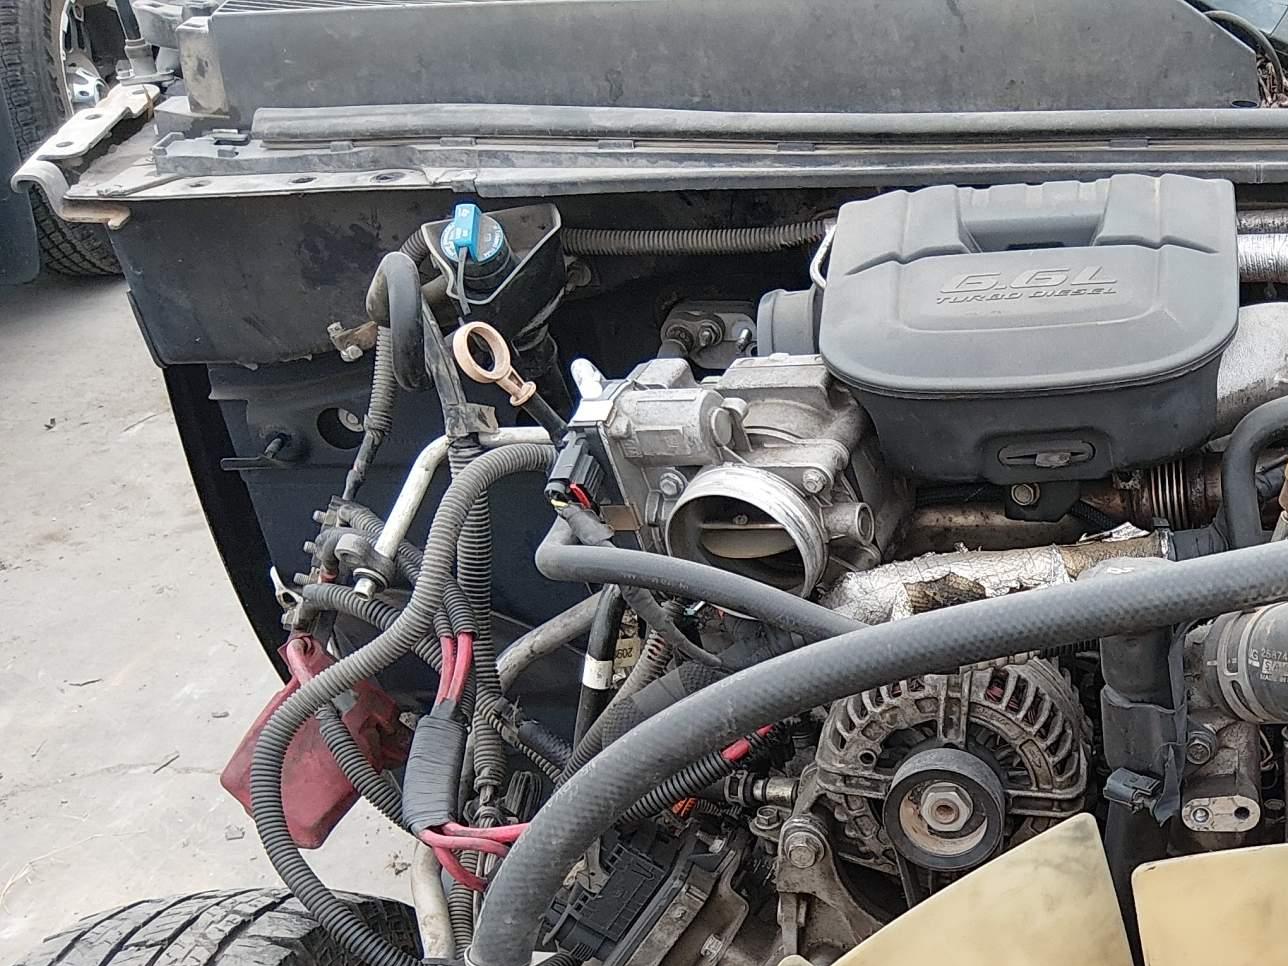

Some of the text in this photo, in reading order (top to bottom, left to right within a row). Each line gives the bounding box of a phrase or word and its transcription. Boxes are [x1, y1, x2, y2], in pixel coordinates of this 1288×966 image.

[940, 266, 1118, 293] 6.6L
[936, 287, 1118, 305] TURBO DIESEL
